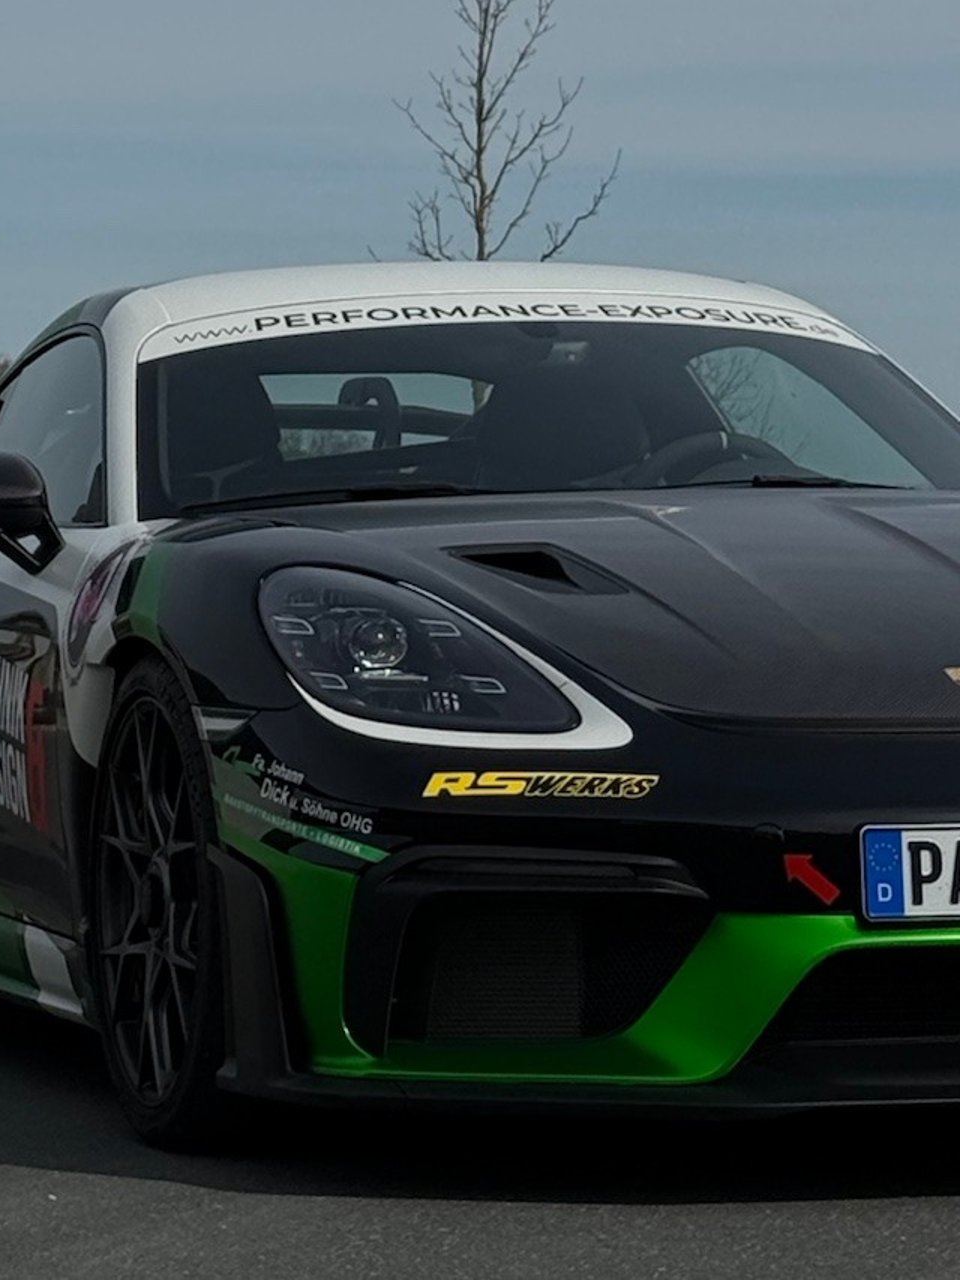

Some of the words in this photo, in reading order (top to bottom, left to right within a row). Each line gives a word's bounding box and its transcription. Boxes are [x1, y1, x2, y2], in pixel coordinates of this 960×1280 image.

[267, 759, 305, 786] Johann
[260, 777, 290, 807] Dick
[301, 797, 338, 824] Söhne
[340, 811, 374, 835] OHG
[877, 882, 893, 902] D
[908, 841, 960, 906] P
